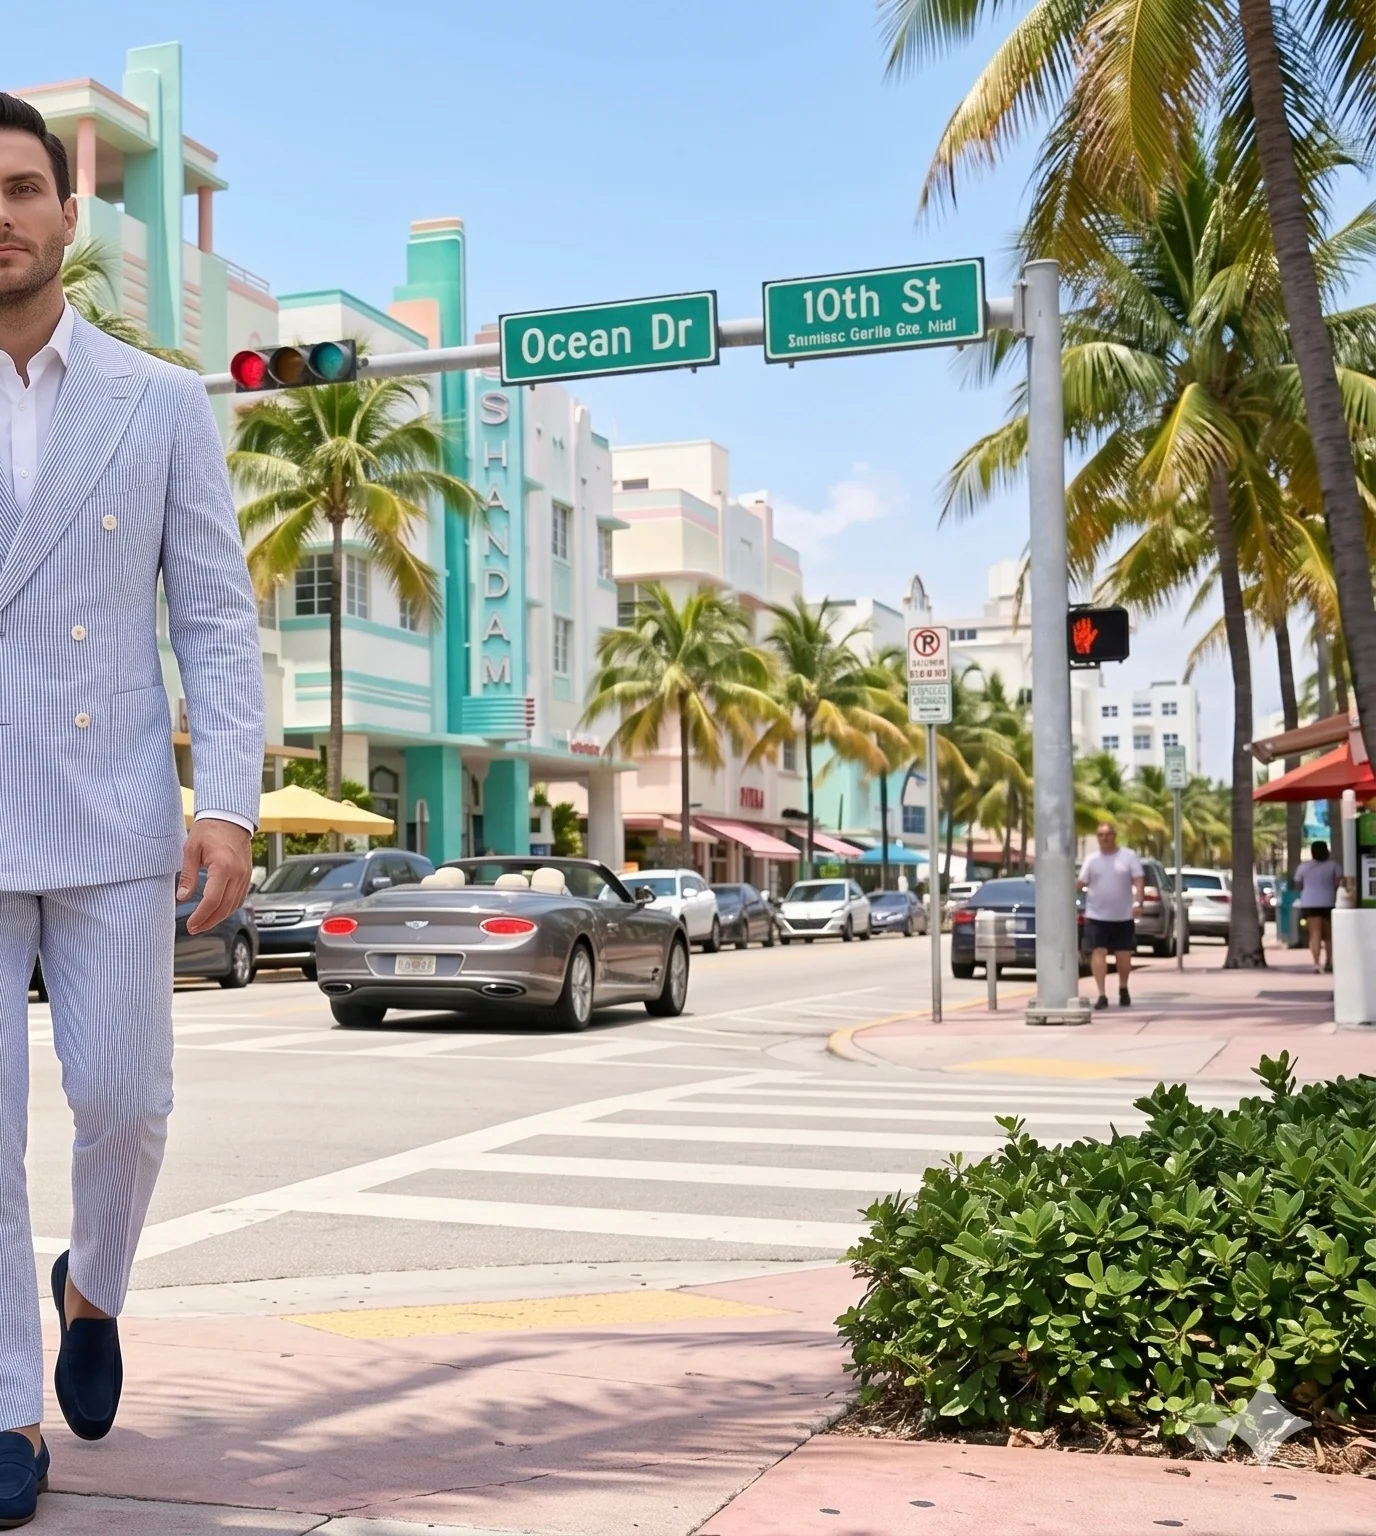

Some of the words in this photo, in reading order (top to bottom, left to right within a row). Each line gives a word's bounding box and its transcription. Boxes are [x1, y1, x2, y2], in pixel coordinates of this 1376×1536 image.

[803, 284, 880, 324] 10th
[901, 276, 942, 313] St
[521, 326, 631, 364] Ocean
[651, 313, 693, 350] Dr
[480, 392, 511, 685] SHANDAM
